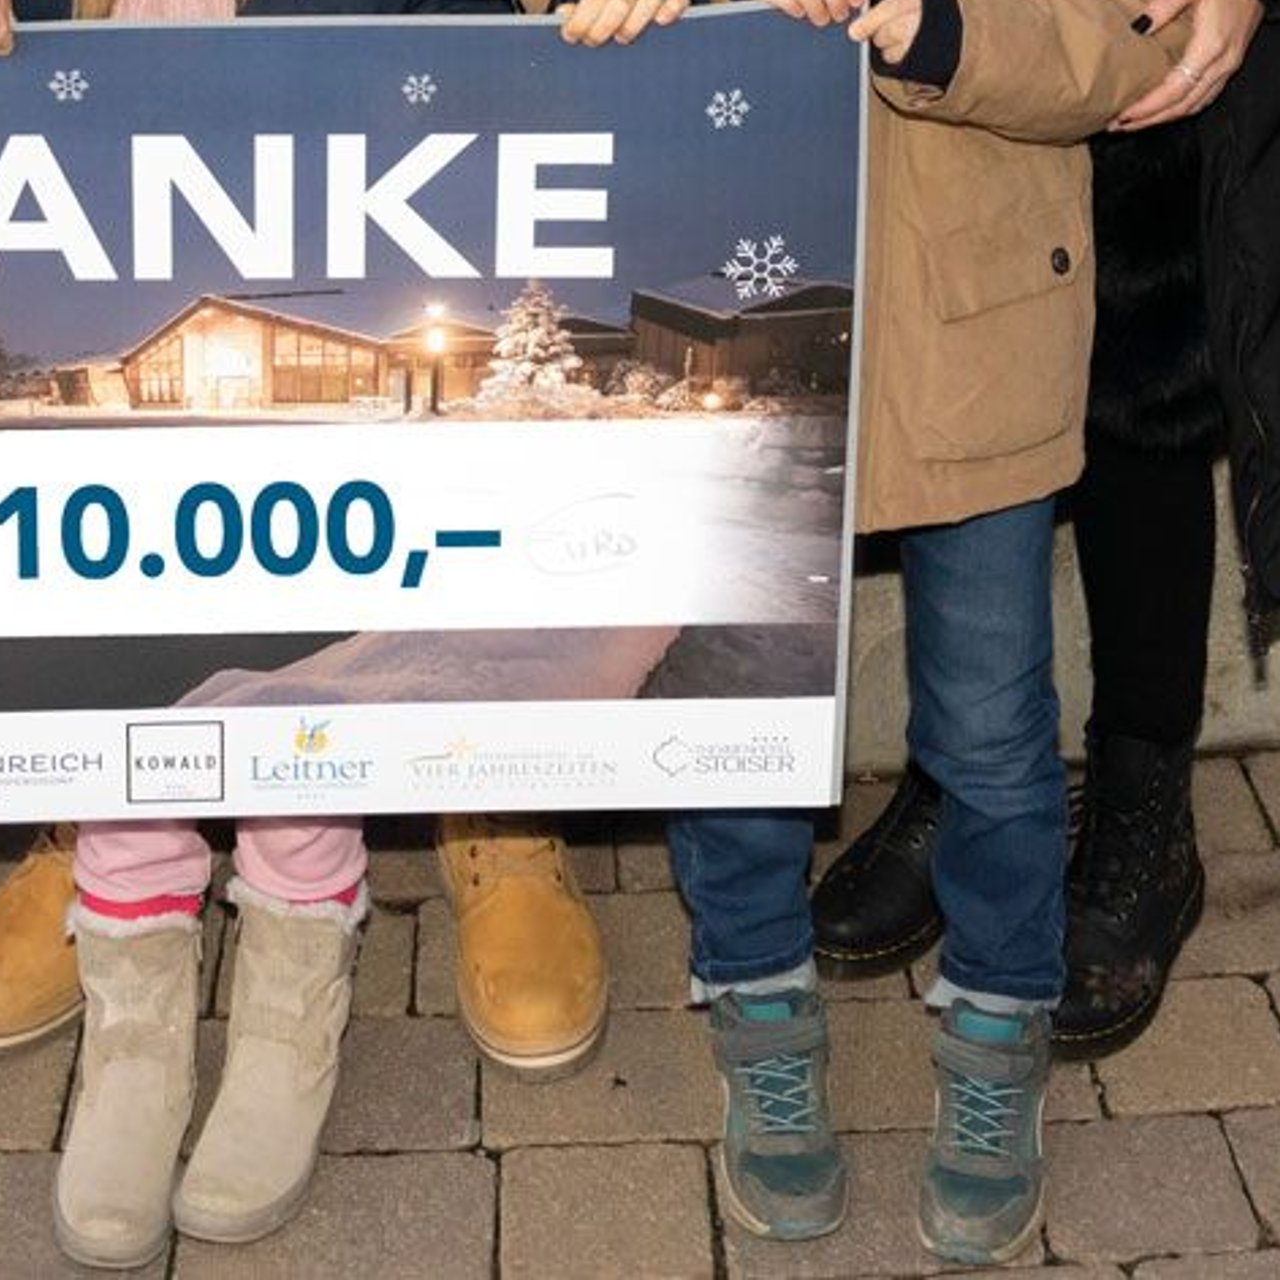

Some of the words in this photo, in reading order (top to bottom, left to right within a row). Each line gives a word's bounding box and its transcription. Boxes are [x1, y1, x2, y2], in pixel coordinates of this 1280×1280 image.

[135, 755, 217, 770] KOWALD
[251, 754, 374, 781] Leitner
[412, 763, 460, 777] VIER
[468, 762, 617, 778] JAHRESZEITEN
[694, 755, 795, 773] STOISER
